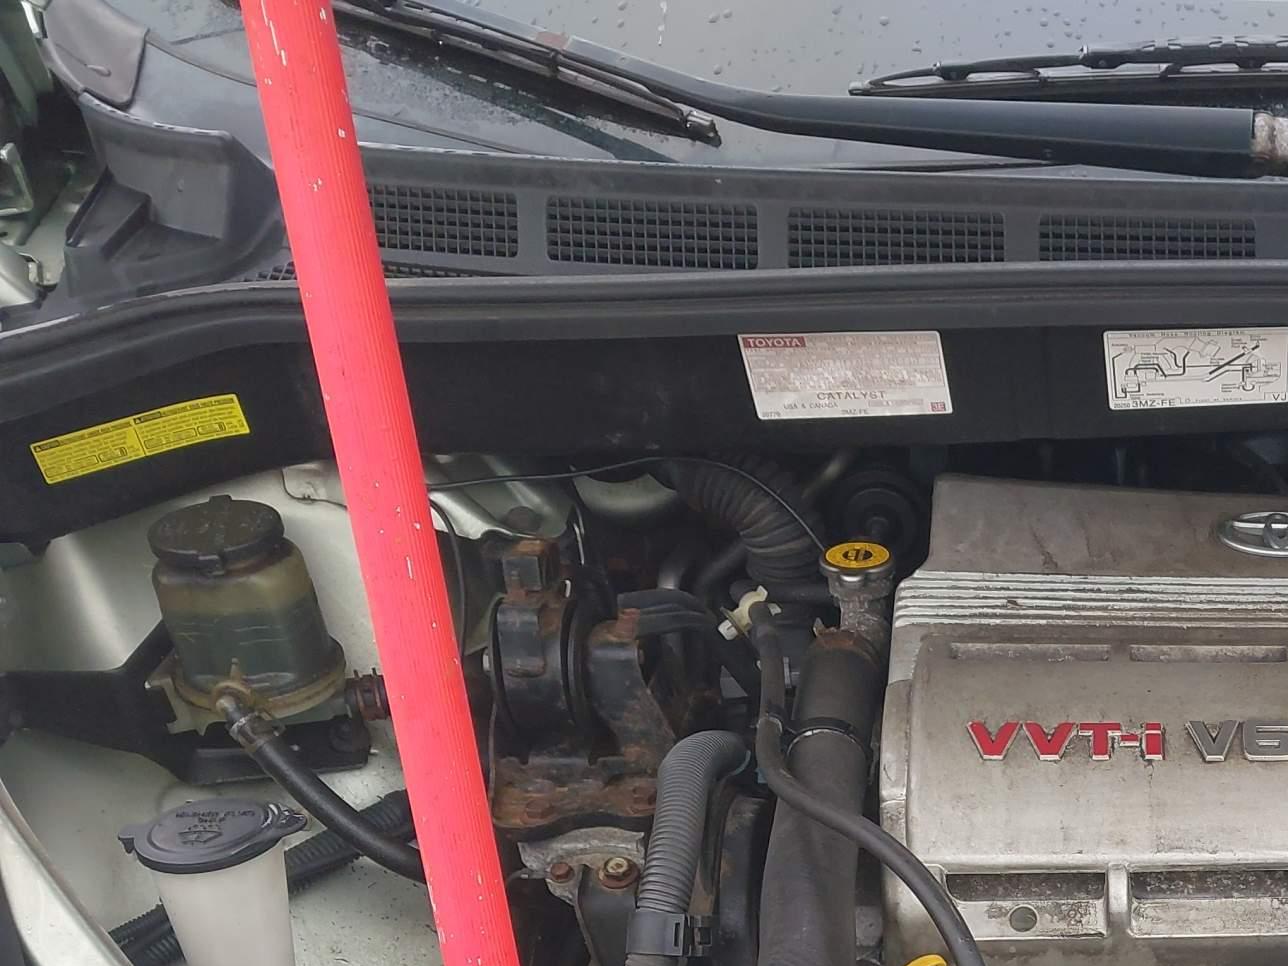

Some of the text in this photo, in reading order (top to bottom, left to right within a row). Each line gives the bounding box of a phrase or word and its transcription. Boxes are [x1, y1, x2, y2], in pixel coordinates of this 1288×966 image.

[746, 337, 802, 348] TOYOTA
[815, 390, 887, 402] CATALYST
[1272, 391, 1287, 402] VJ
[809, 400, 839, 410] CANADA
[1132, 398, 1177, 409] 3MZ-FE
[966, 720, 1166, 761] VVT-i
